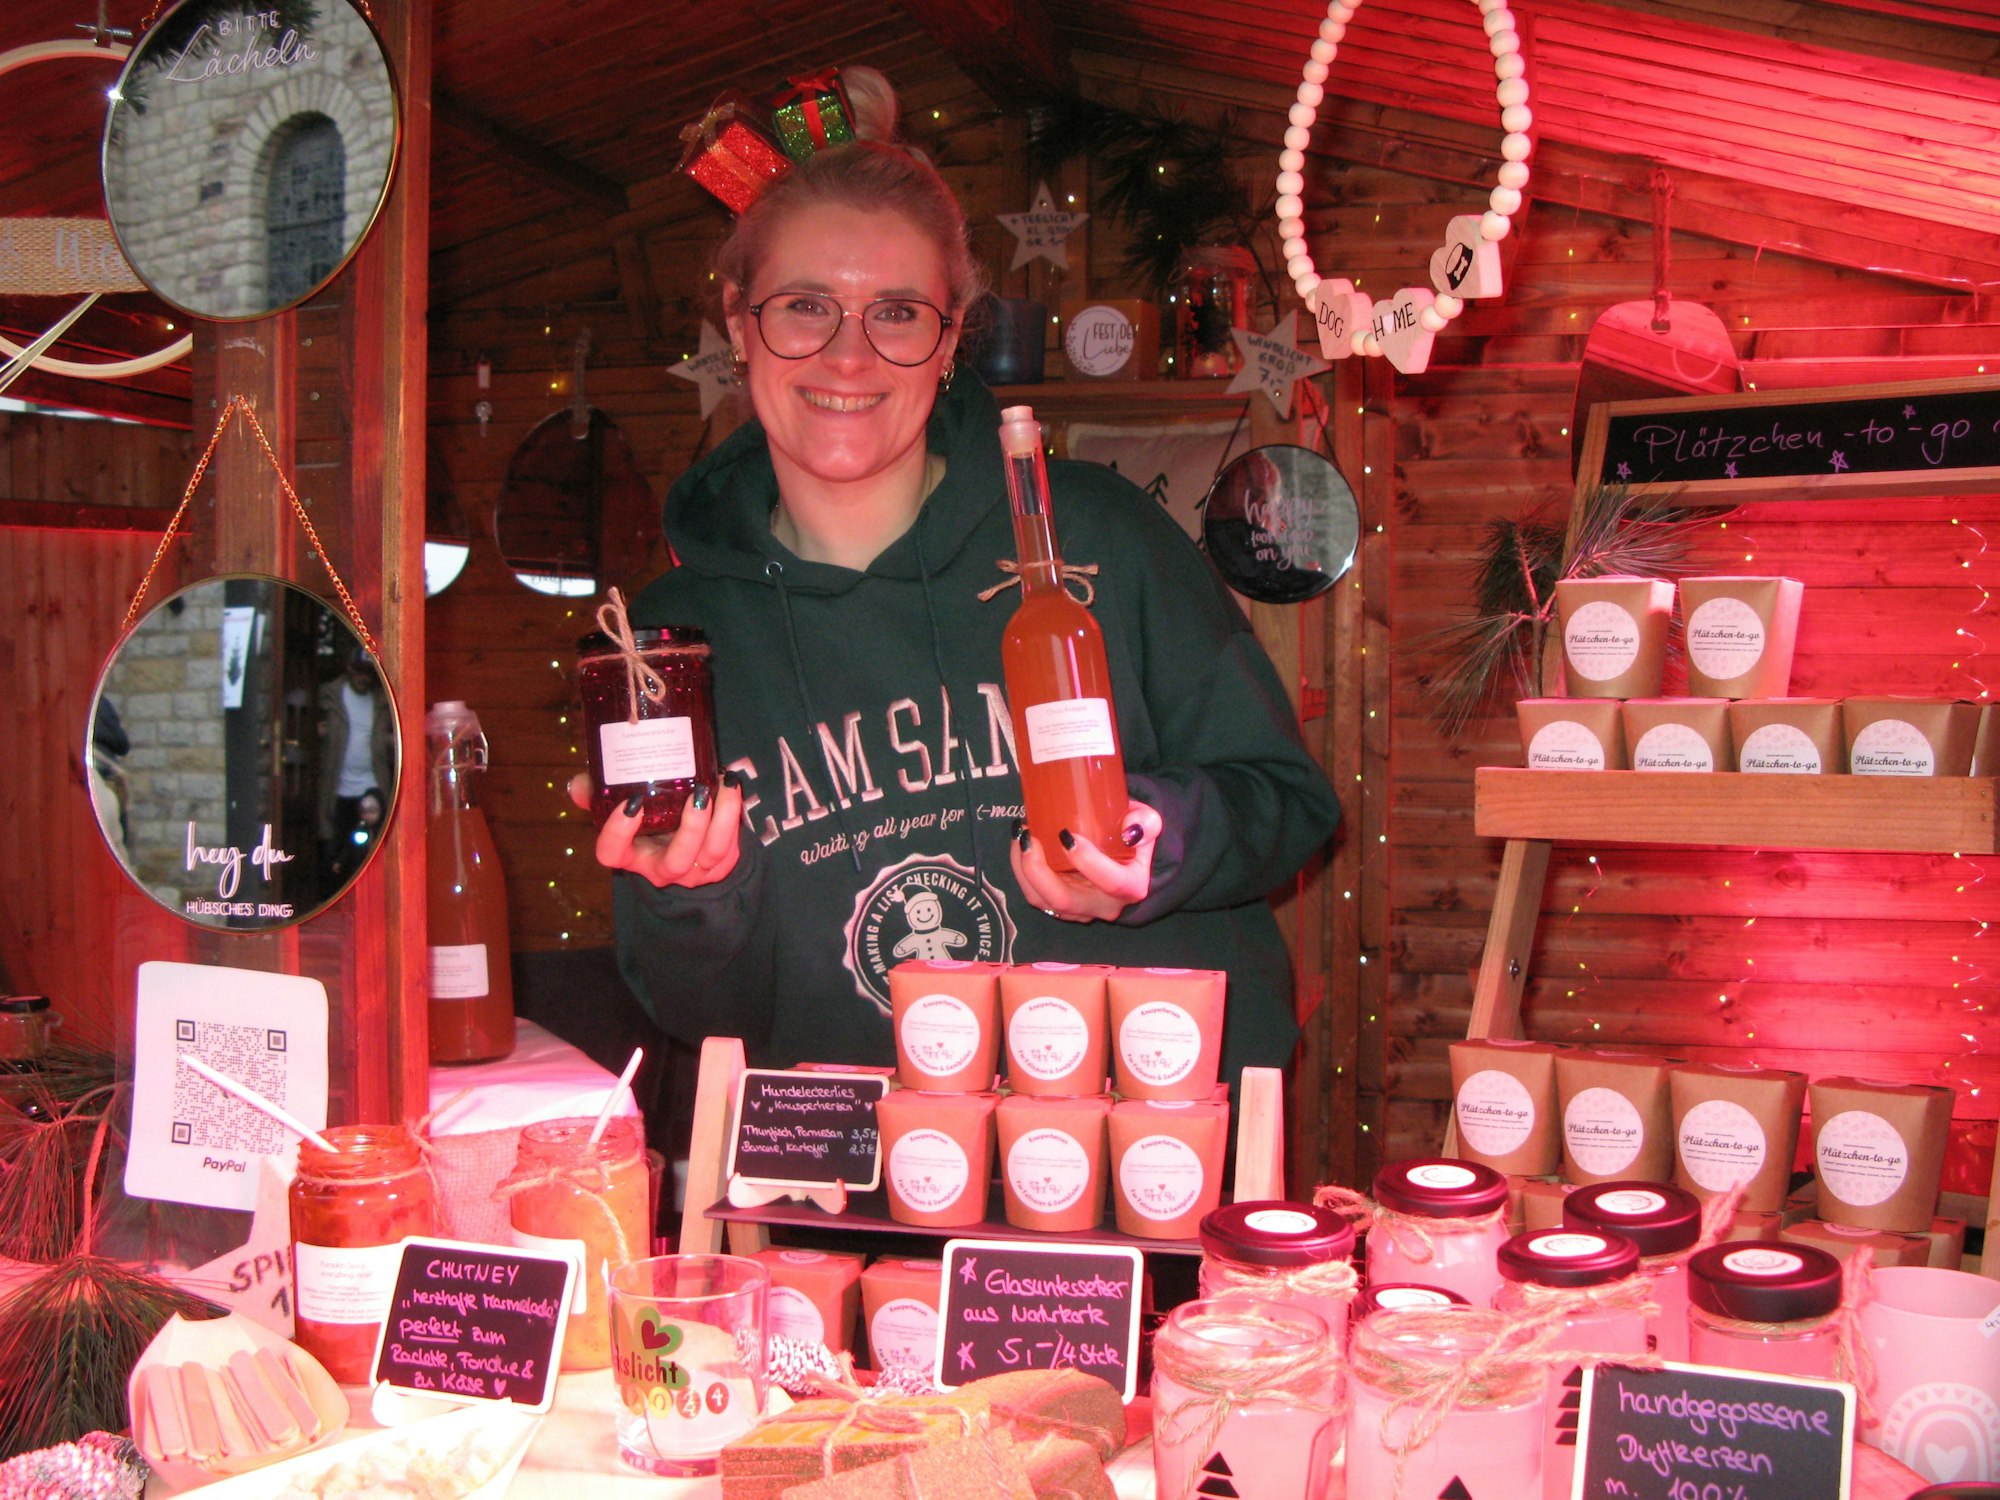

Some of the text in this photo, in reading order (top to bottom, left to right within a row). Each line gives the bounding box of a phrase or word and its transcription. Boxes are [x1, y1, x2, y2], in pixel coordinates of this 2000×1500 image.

[218, 10, 281, 36] BITTE
[166, 24, 320, 82] Lächeln
[1318, 301, 1344, 338] DOG
[1093, 322, 1116, 340] FEST
[1083, 328, 1131, 360] Liebe
[1633, 422, 1824, 464] Plätzchen
[1256, 547, 1278, 561] on
[1568, 633, 1635, 646] Plätzchen-to-go
[1691, 628, 1760, 642] Plätzchen-to-go
[1531, 752, 1599, 765] Plätzchen-to-go
[1637, 756, 1708, 769] Plätzchen-to-go
[1745, 757, 1818, 771] Plätzchen-to-go
[1854, 754, 1928, 769] Plätzchen-to-go
[800, 829, 870, 866] Waitig
[873, 816, 897, 838] all
[899, 813, 937, 839] year
[940, 806, 964, 831] for
[186, 821, 294, 898] hey du
[905, 872, 969, 900] CHECKING
[186, 896, 294, 918] HÜBSCHES DING
[966, 896, 983, 911] IT
[871, 912, 884, 924] A
[975, 913, 992, 958] TWICE
[866, 925, 887, 975] MAKING
[1460, 1102, 1529, 1118] Plätzchen-to-go
[795, 1125, 844, 1139] Parmesan
[1567, 1122, 1637, 1138] Plätzchen-to-go
[786, 1142, 829, 1160] Kartoffel
[1682, 1133, 1760, 1153] Plätzchen-to-go
[203, 1156, 247, 1173] PayPal
[1820, 1145, 1901, 1166] Plätzchen-to-go
[426, 1259, 520, 1286] CHUTNEY
[984, 1268, 1129, 1299] Glasuntersetzer
[963, 1306, 1000, 1323] aus
[399, 1316, 507, 1346] perfekt zum
[456, 1351, 519, 1378] Fondue
[520, 1359, 535, 1380] &
[414, 1371, 485, 1394] zu Käse
[1618, 1381, 1832, 1439] handgegossene
[1616, 1433, 1774, 1478] Duftkerzen
